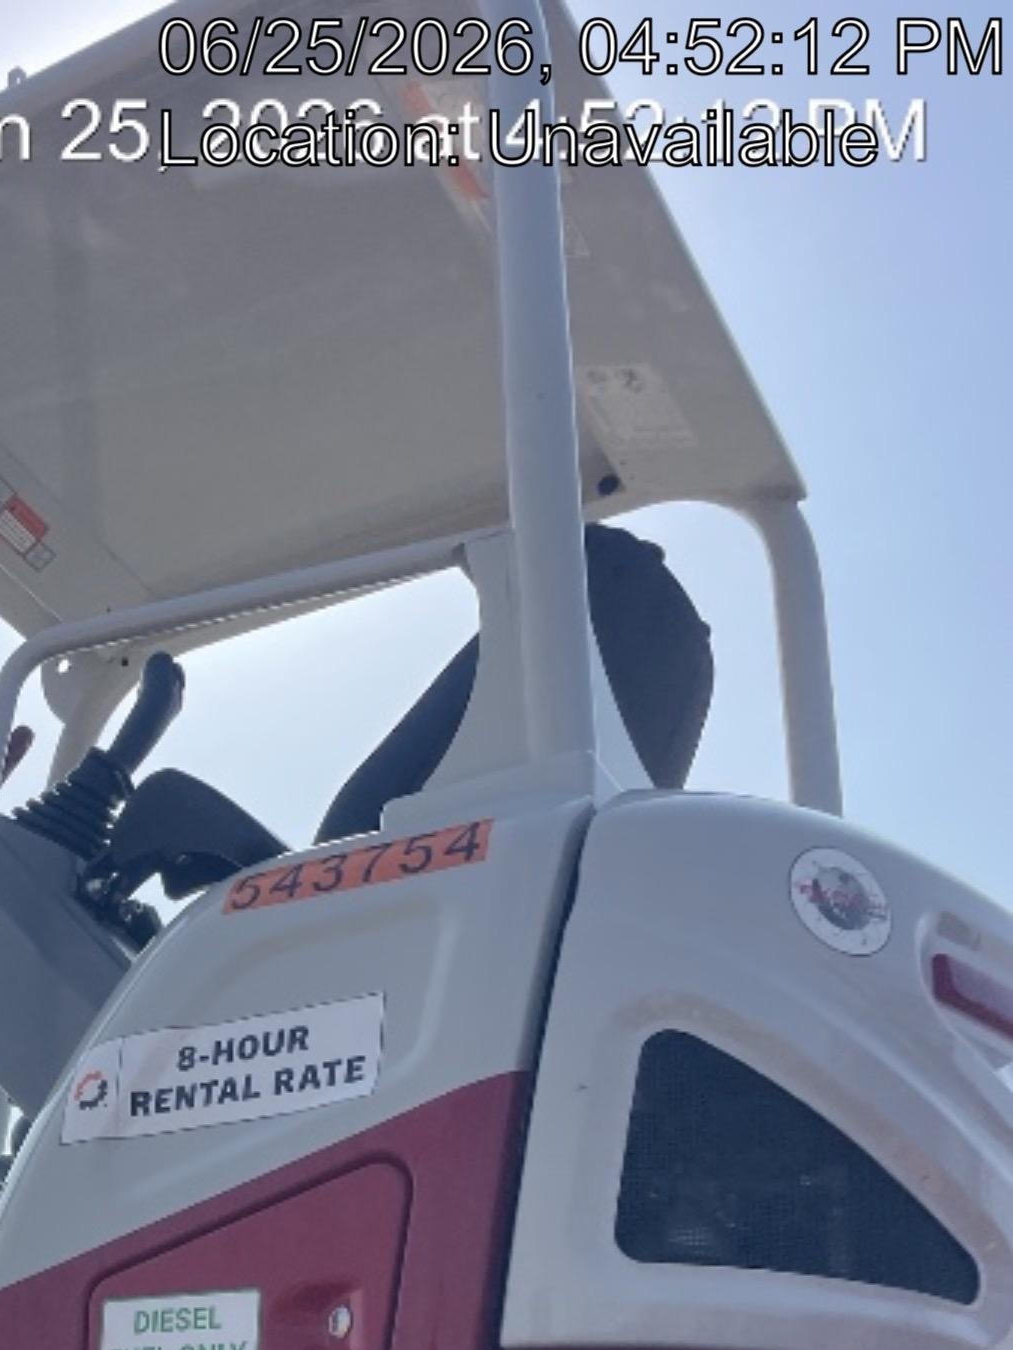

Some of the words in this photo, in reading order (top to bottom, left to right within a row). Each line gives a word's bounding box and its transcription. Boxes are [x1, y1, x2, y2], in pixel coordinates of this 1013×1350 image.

[229, 820, 482, 911] 543754
[176, 1024, 310, 1072] 8-HOUR
[129, 1073, 261, 1117] RENTAL
[273, 1055, 366, 1096] RATE
[133, 1305, 222, 1335] DIESEL
